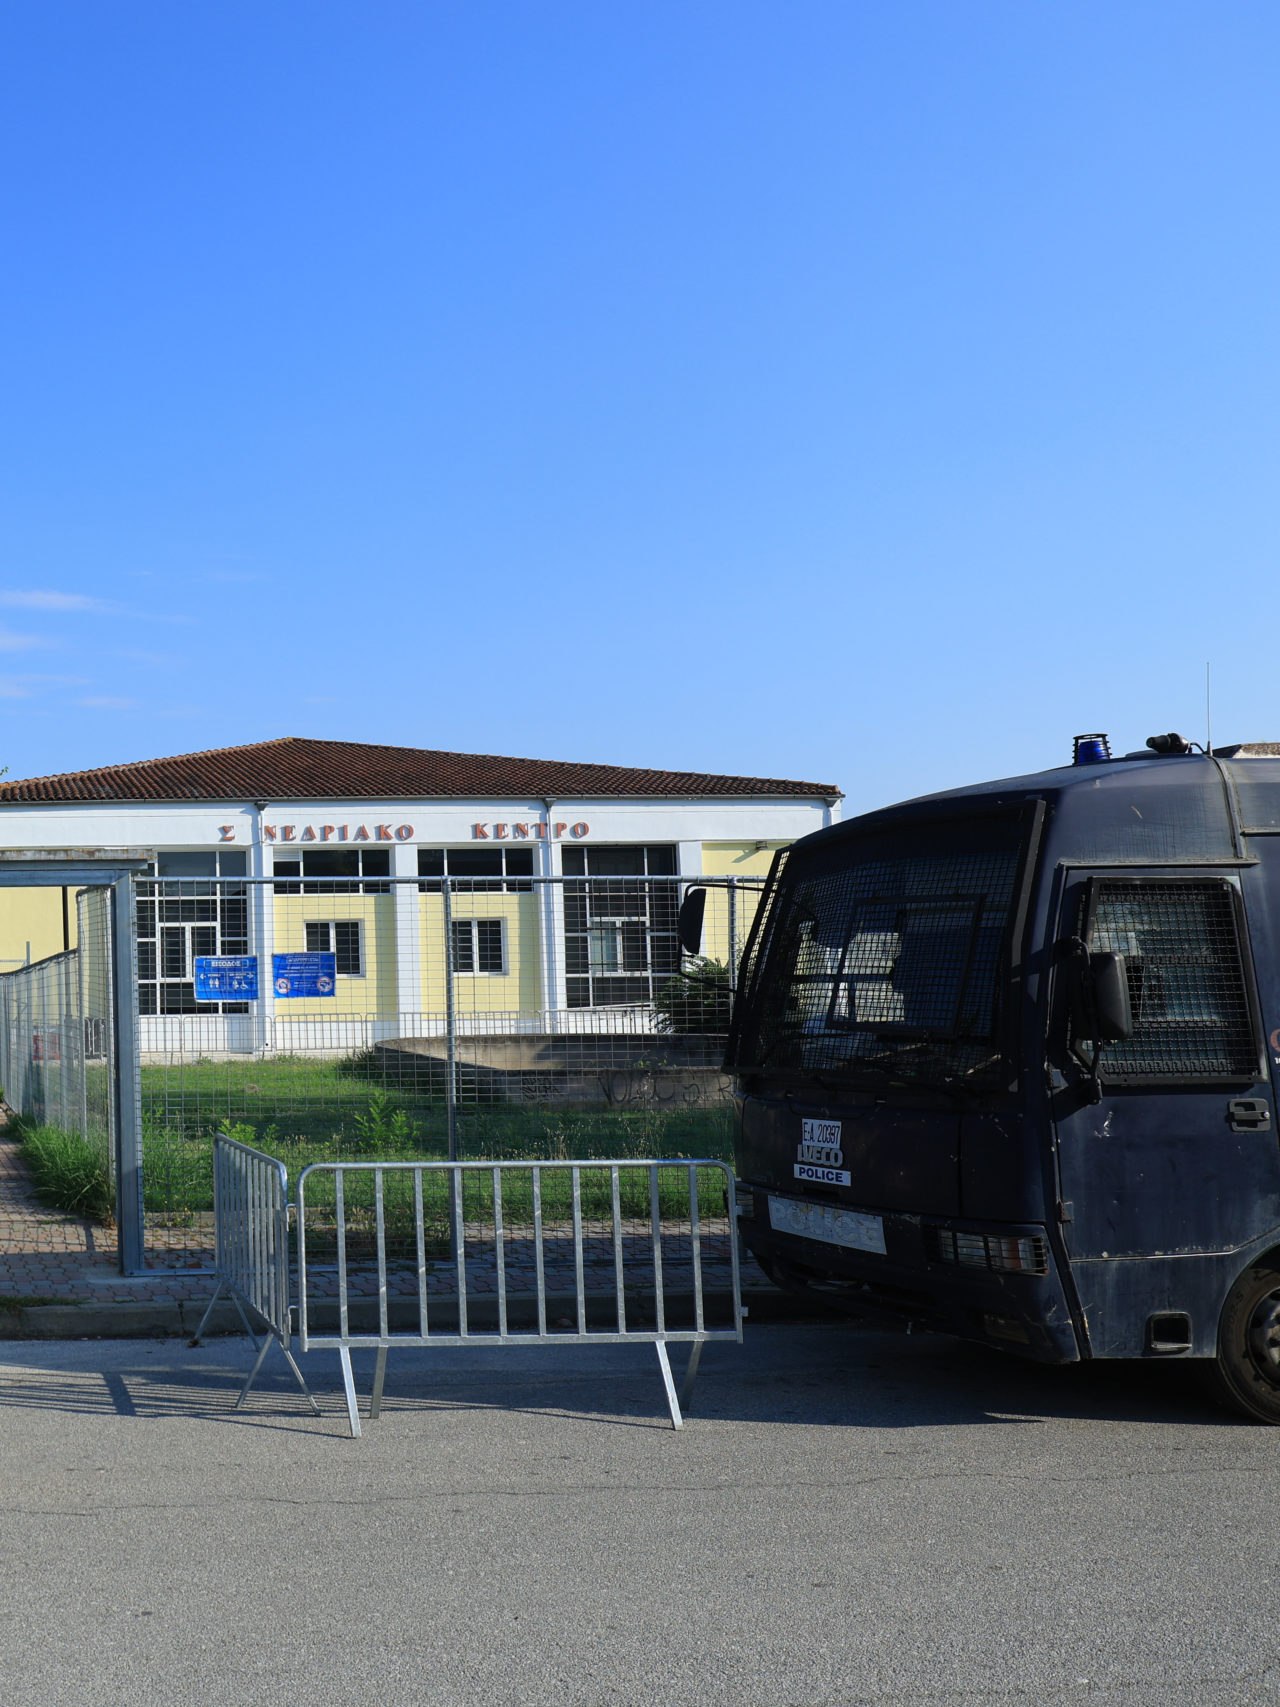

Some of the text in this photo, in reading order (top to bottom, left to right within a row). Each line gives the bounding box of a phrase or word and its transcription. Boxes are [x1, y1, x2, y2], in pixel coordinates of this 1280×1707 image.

[473, 822, 590, 840] ΚΕΝΤΡΟ
[797, 1144, 843, 1167] IVECO
[799, 1166, 844, 1183] POLICE
